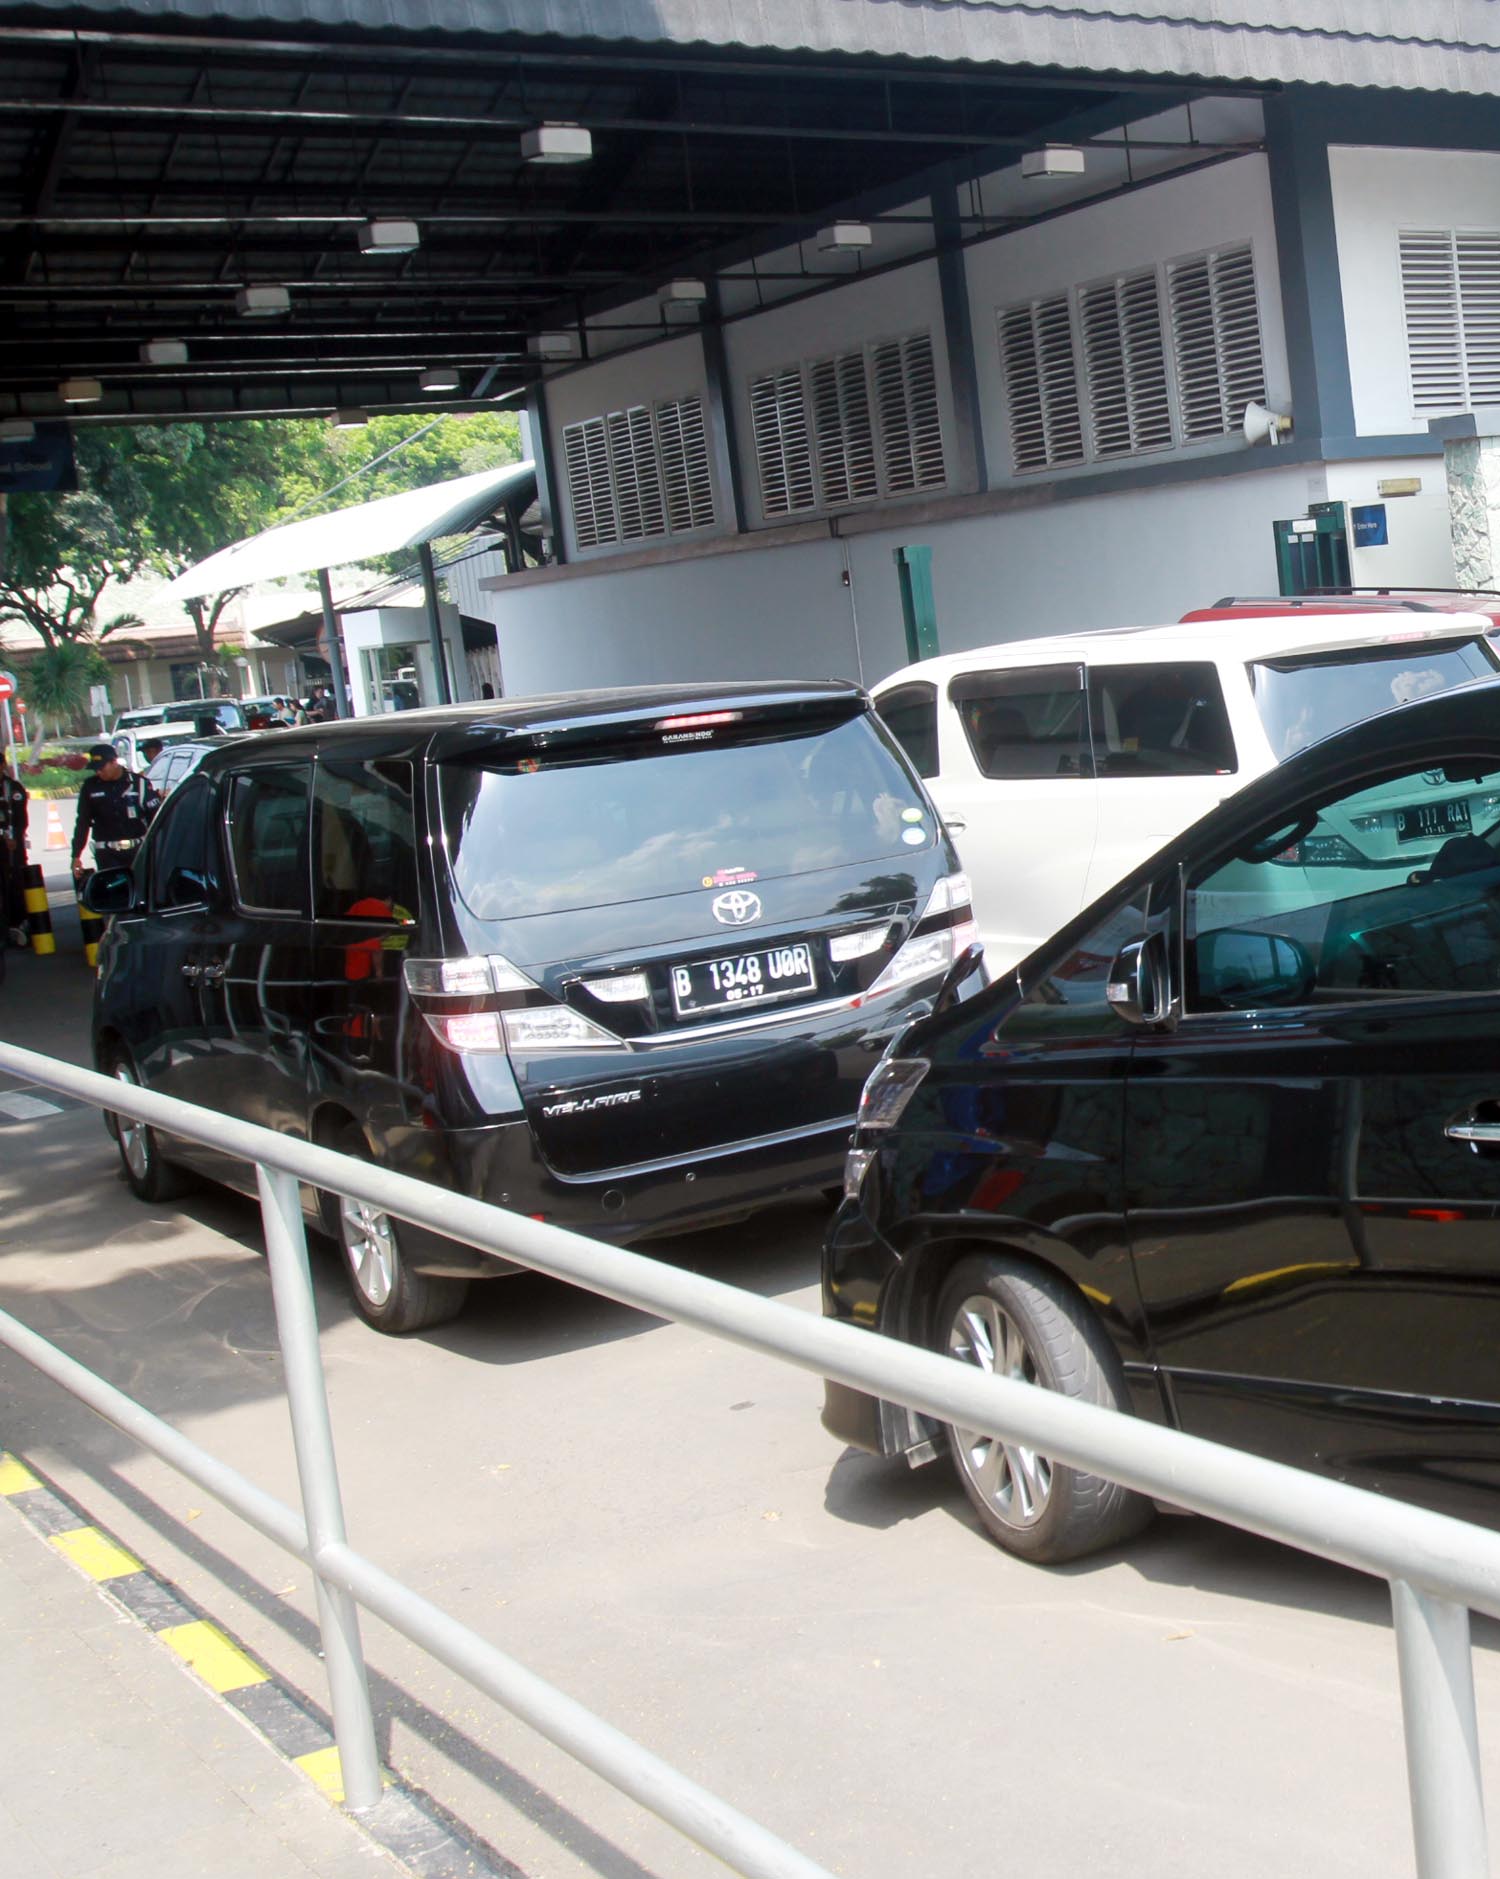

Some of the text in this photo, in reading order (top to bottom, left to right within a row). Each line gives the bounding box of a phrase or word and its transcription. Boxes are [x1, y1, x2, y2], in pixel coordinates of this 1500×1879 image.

[1398, 813, 1406, 831] B
[1448, 801, 1468, 822] RAT
[675, 969, 692, 997] B
[709, 957, 762, 990] 1348
[543, 1090, 641, 1117] VELLFIRE
